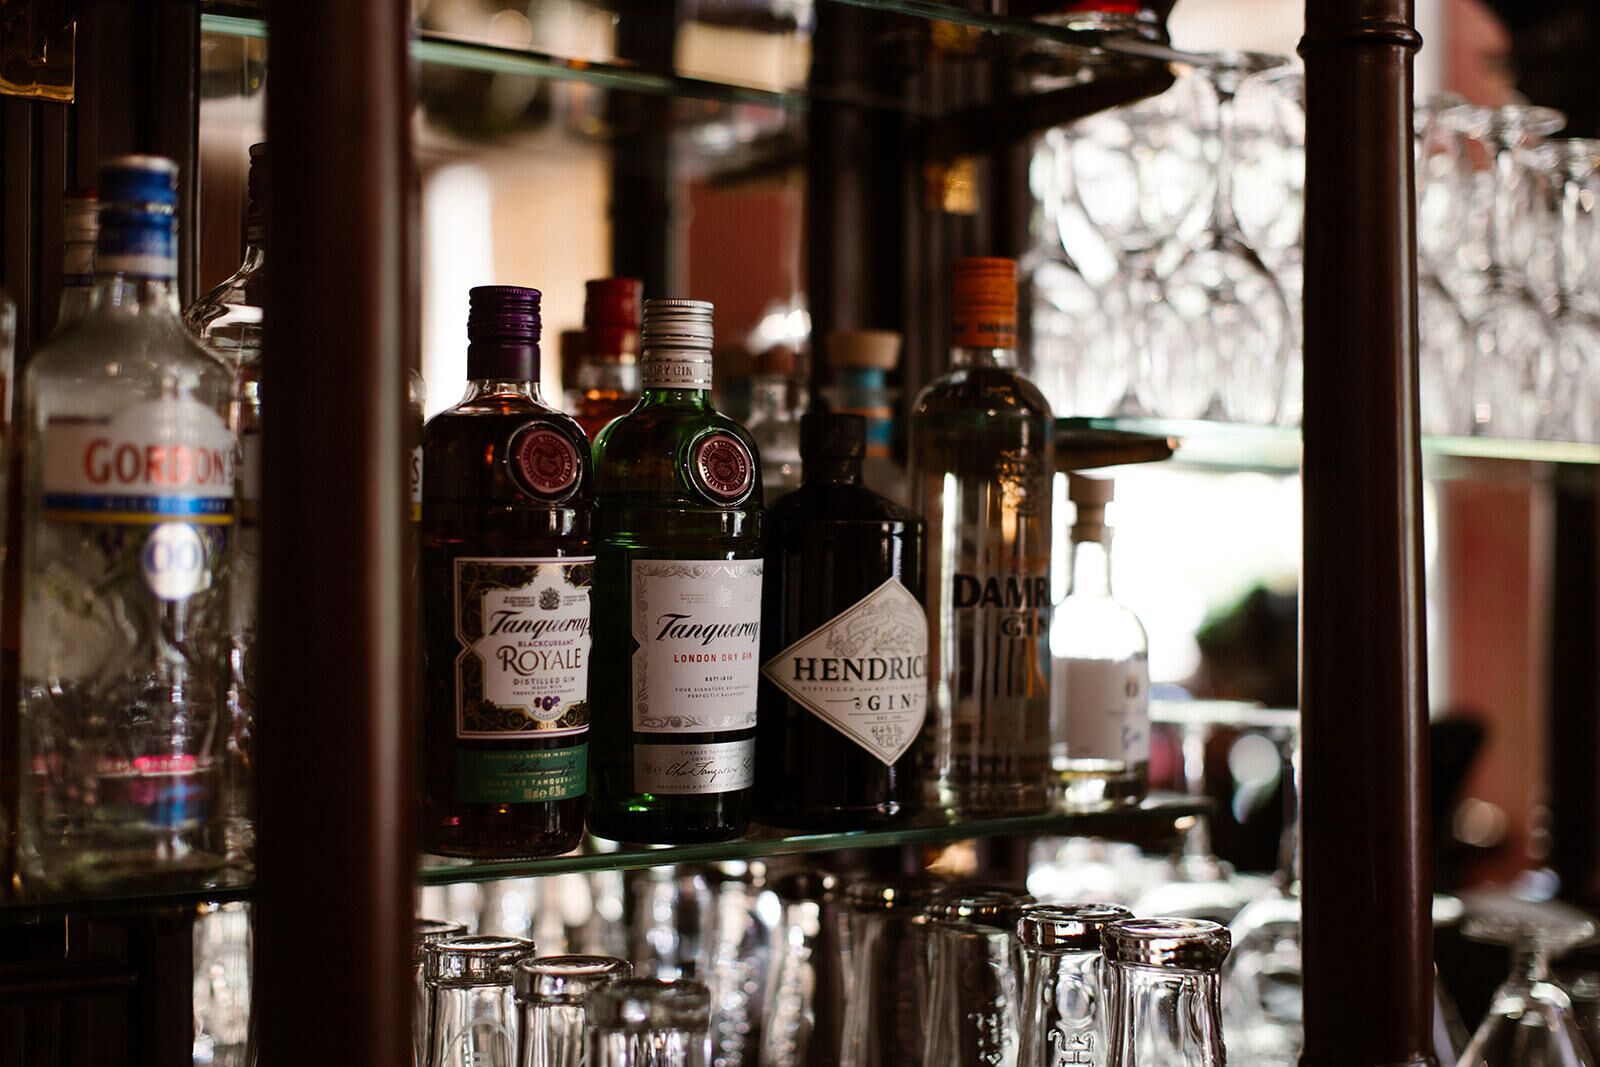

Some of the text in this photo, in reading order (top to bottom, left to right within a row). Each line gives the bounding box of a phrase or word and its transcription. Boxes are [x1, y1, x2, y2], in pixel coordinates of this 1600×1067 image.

[674, 365, 693, 376] GIN
[489, 610, 589, 639] Tanqueray
[656, 613, 759, 646] Tanqueray
[497, 645, 581, 676] ROYALE
[674, 652, 752, 663] LONDON DRY GIN
[793, 655, 927, 681] HENDRIC
[513, 676, 576, 686] DISTILLED GIN
[867, 694, 911, 711] GIN
